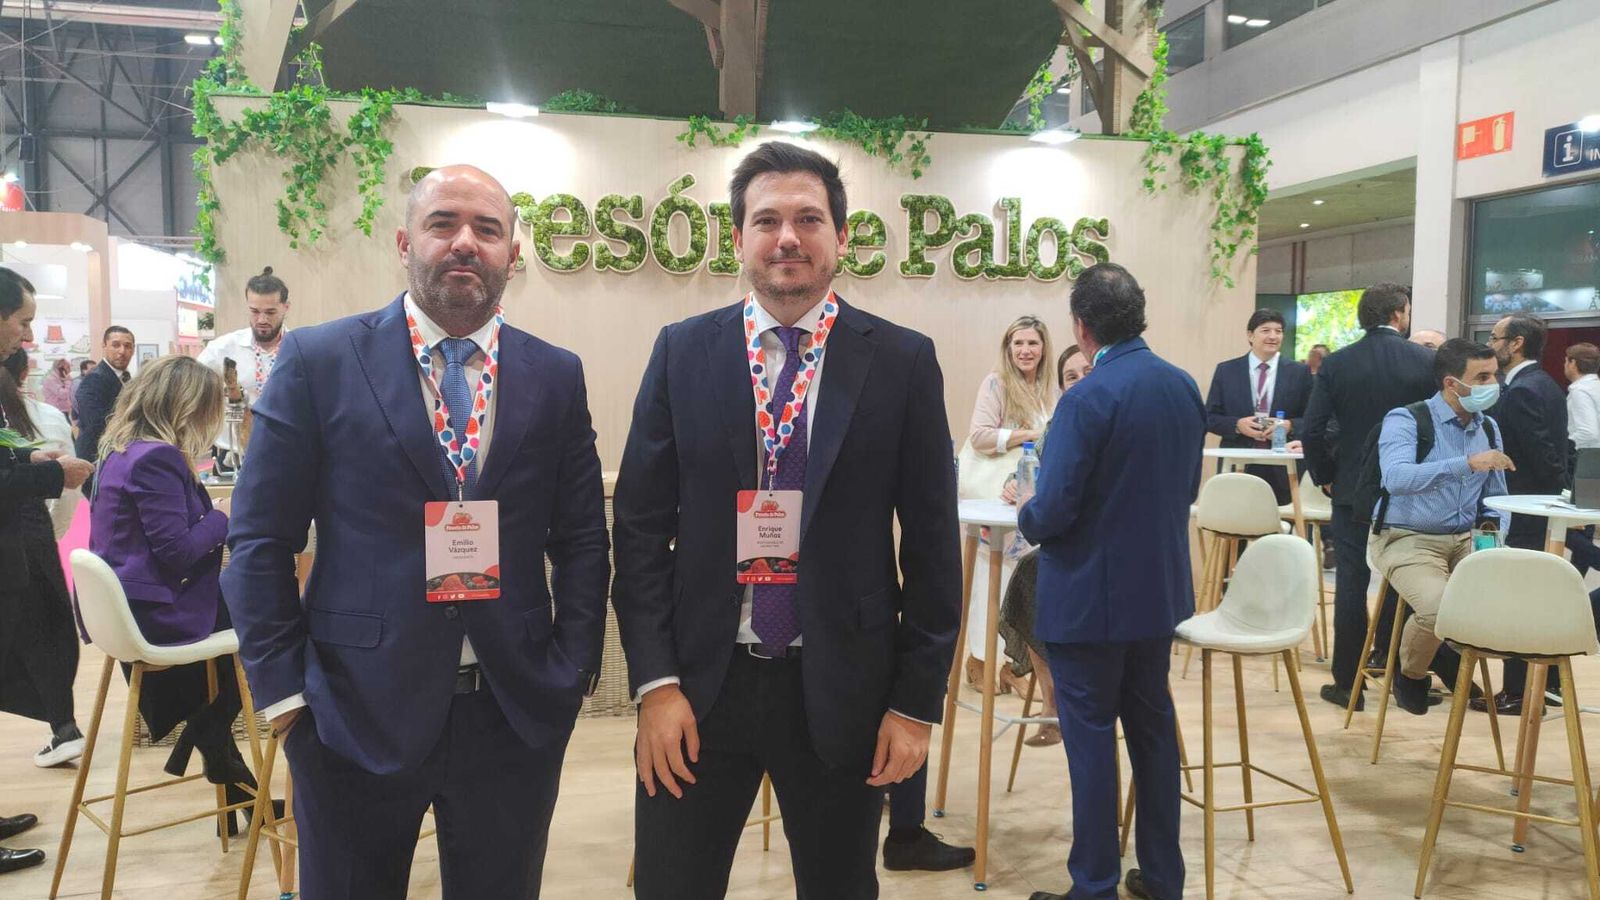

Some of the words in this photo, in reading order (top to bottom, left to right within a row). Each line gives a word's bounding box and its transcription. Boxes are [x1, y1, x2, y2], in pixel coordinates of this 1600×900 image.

[898, 192, 1112, 282] Palos
[757, 525, 783, 533] Enrique
[448, 546, 479, 554] Vázquez
